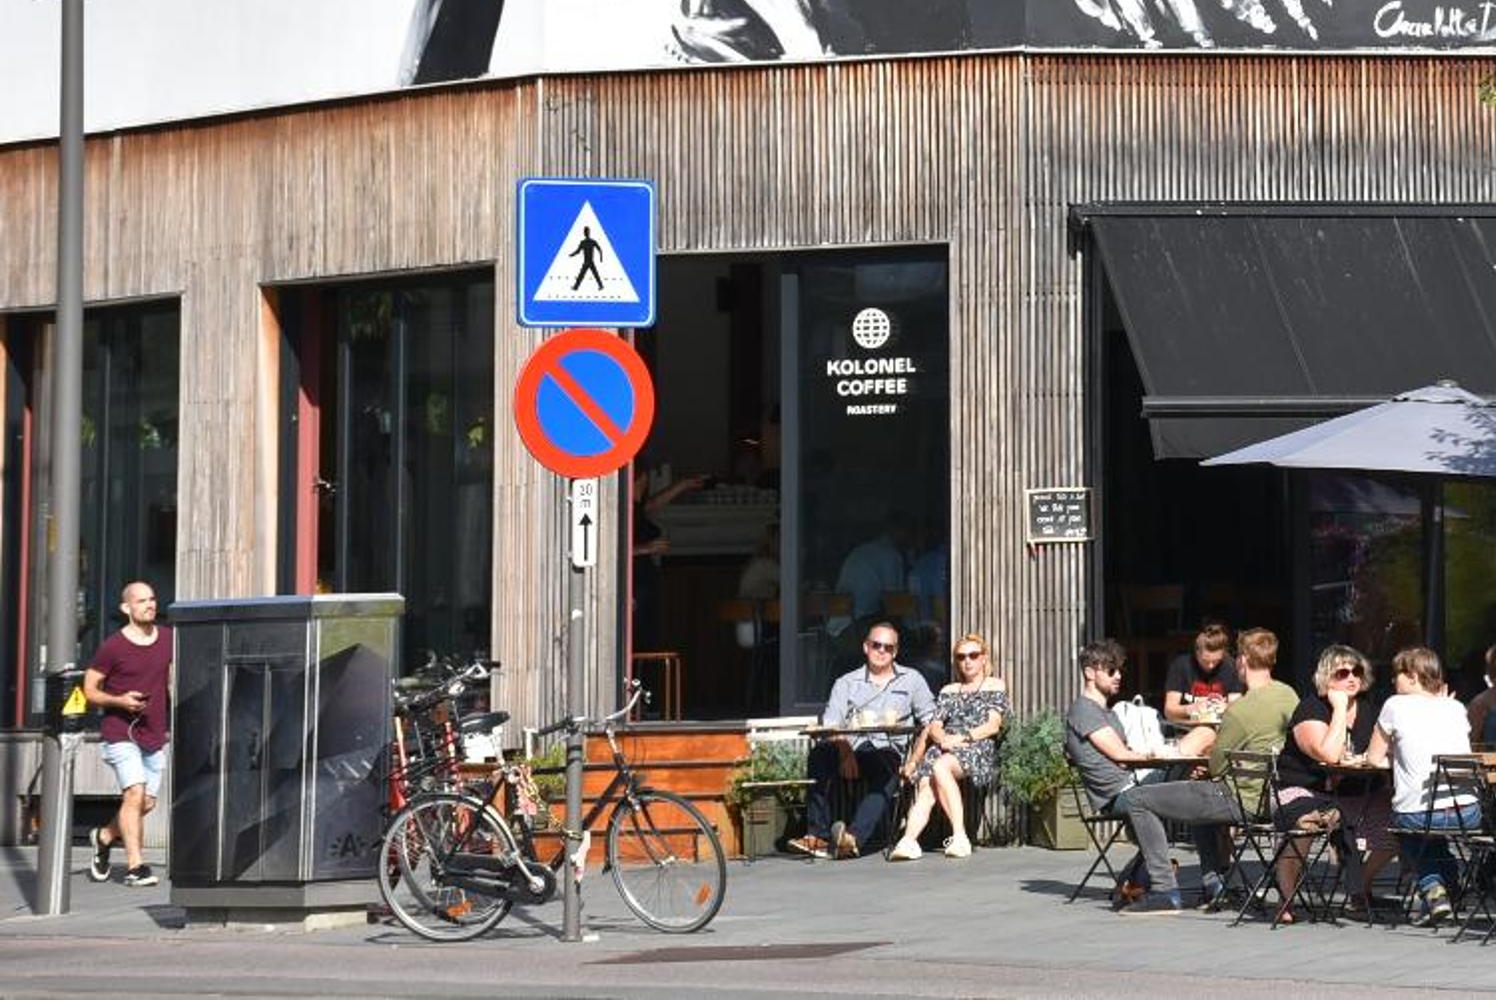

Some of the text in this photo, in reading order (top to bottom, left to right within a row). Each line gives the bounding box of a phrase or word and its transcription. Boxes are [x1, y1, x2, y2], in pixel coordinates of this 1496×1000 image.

[826, 357, 917, 376] KOLONEL
[836, 378, 908, 397] COFFEE
[846, 404, 897, 416] ROASTERY
